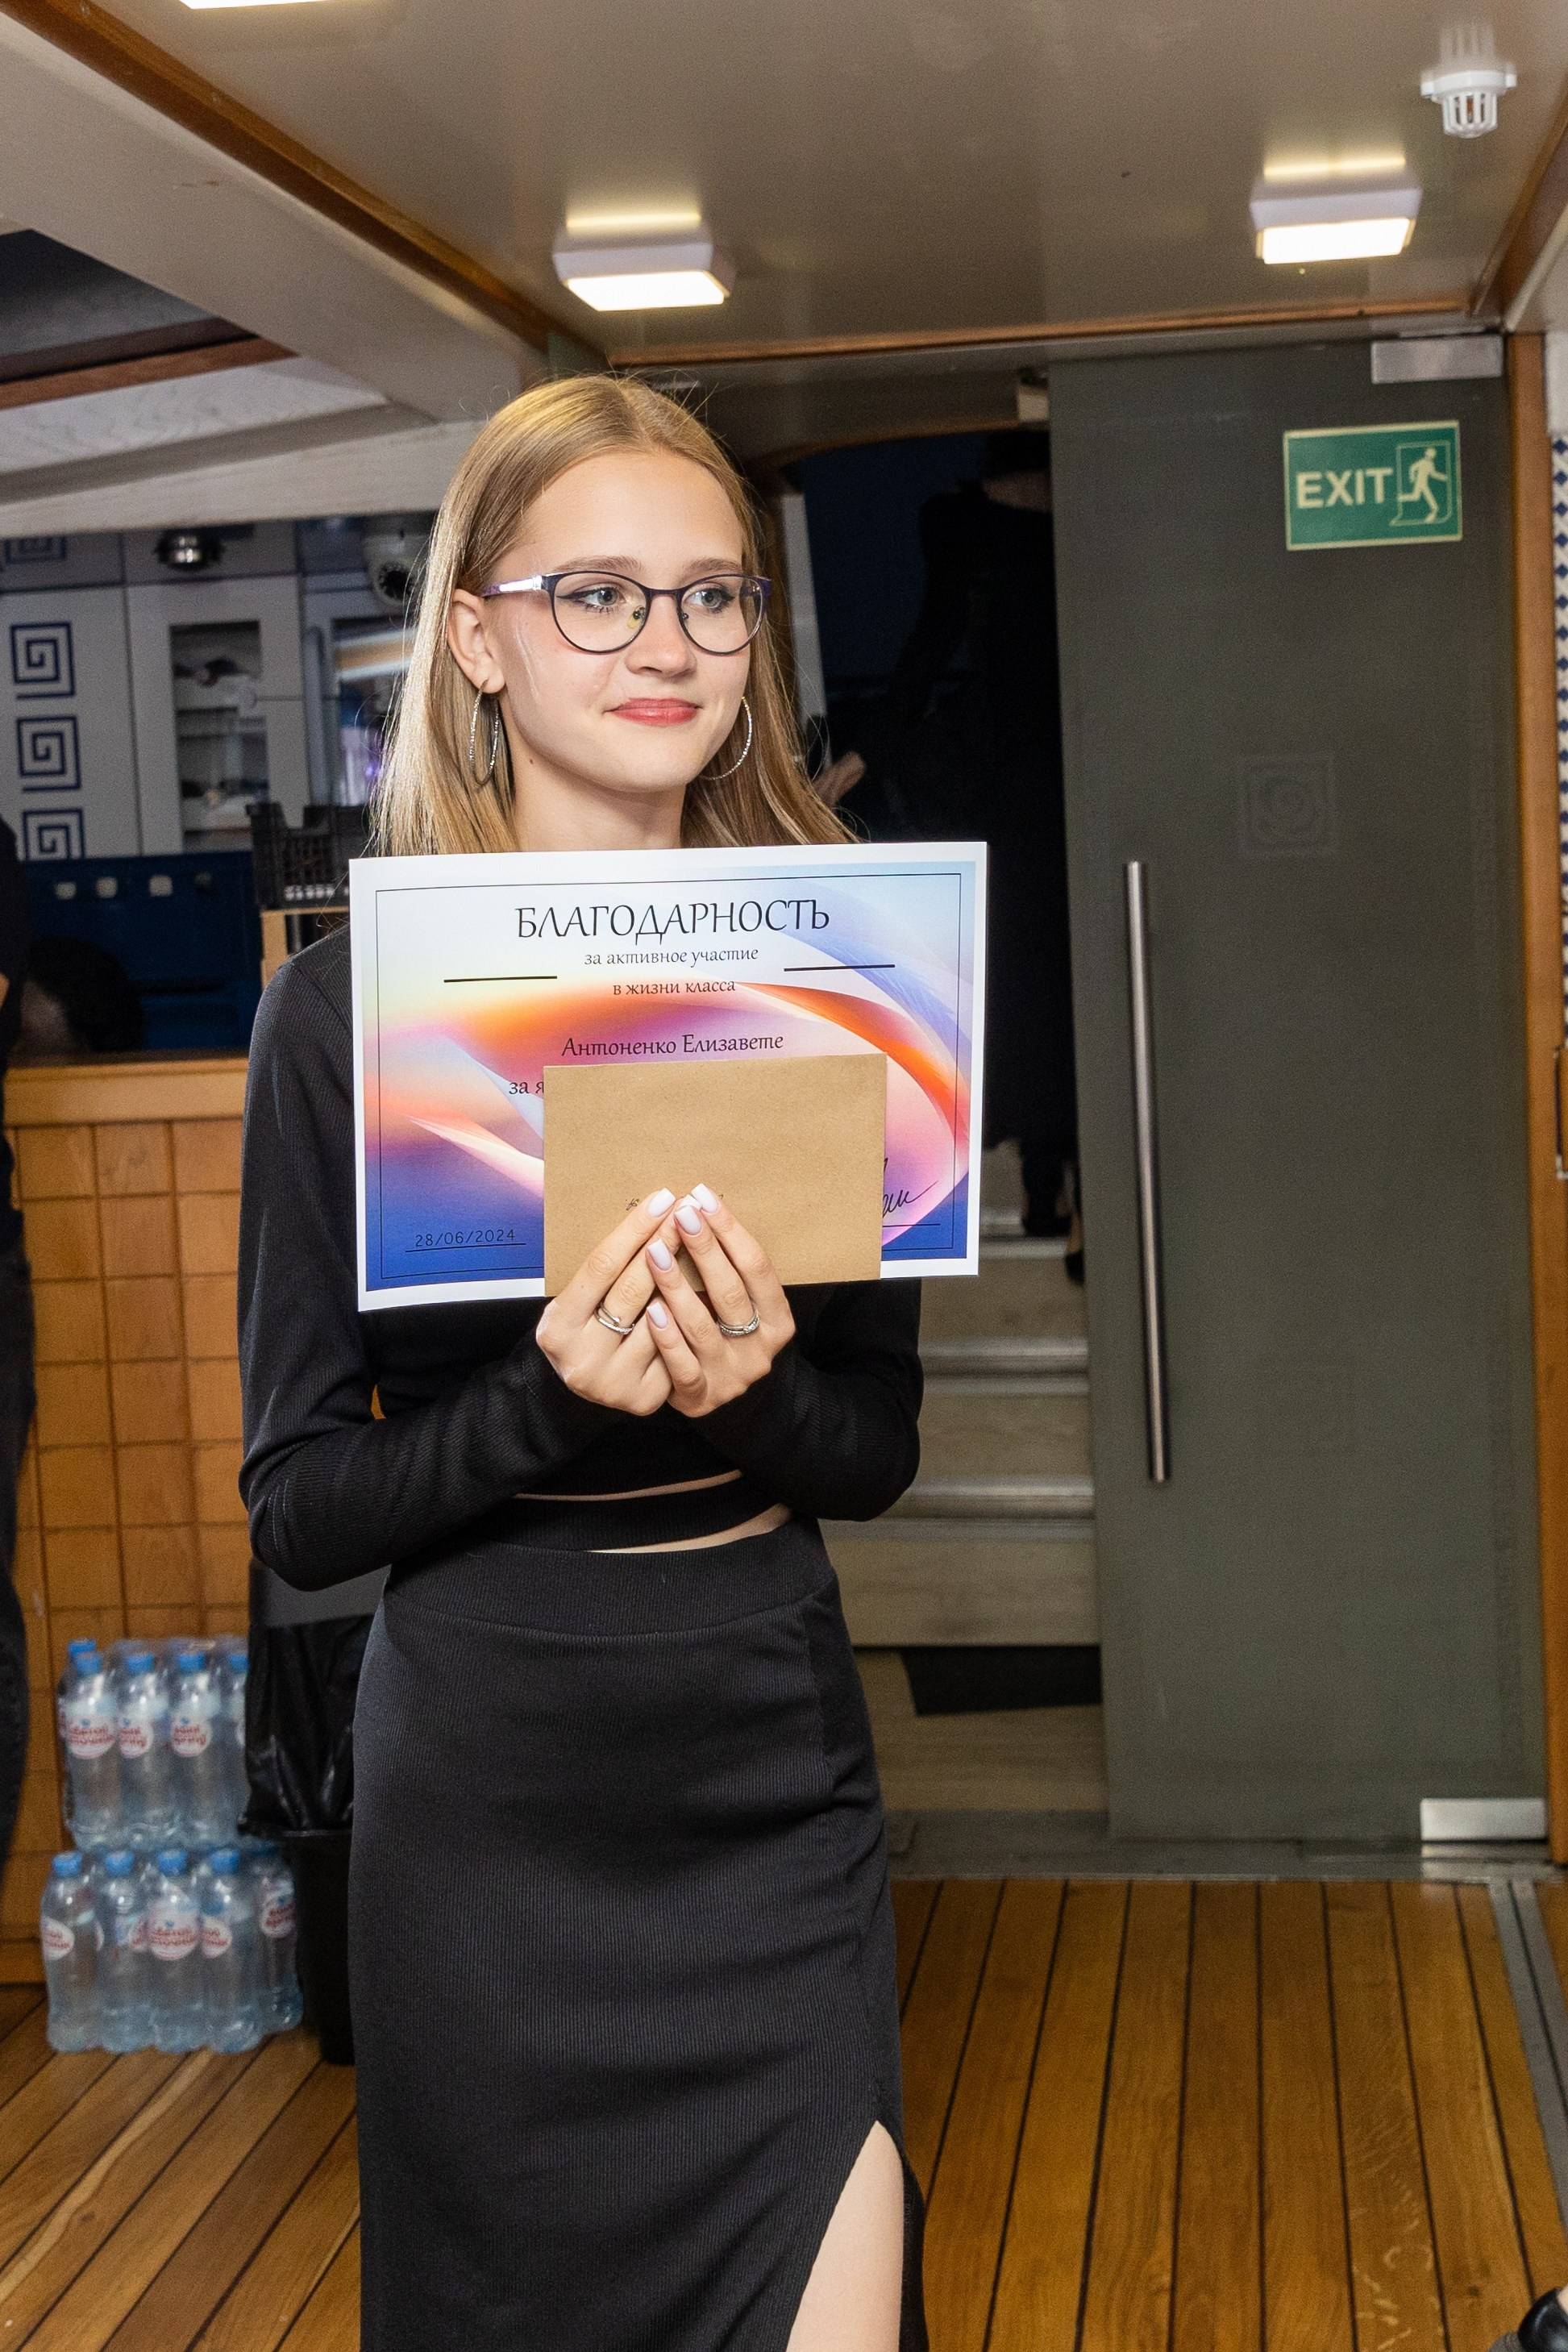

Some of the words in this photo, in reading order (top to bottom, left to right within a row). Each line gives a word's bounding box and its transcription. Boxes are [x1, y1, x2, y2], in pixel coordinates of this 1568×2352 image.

[1296, 466, 1394, 510] EXIT
[514, 899, 830, 946] БЛАГОДАРНОСТЬ
[584, 953, 602, 965] за
[606, 951, 688, 964] активное
[691, 948, 759, 968] участие
[613, 985, 622, 996] в
[626, 983, 680, 996] жизни
[686, 980, 736, 993] класса
[561, 1037, 677, 1057] Антоненко
[682, 1034, 784, 1053] Елизавете
[509, 1081, 530, 1095] за
[415, 1229, 515, 1247] 28/06/2024
